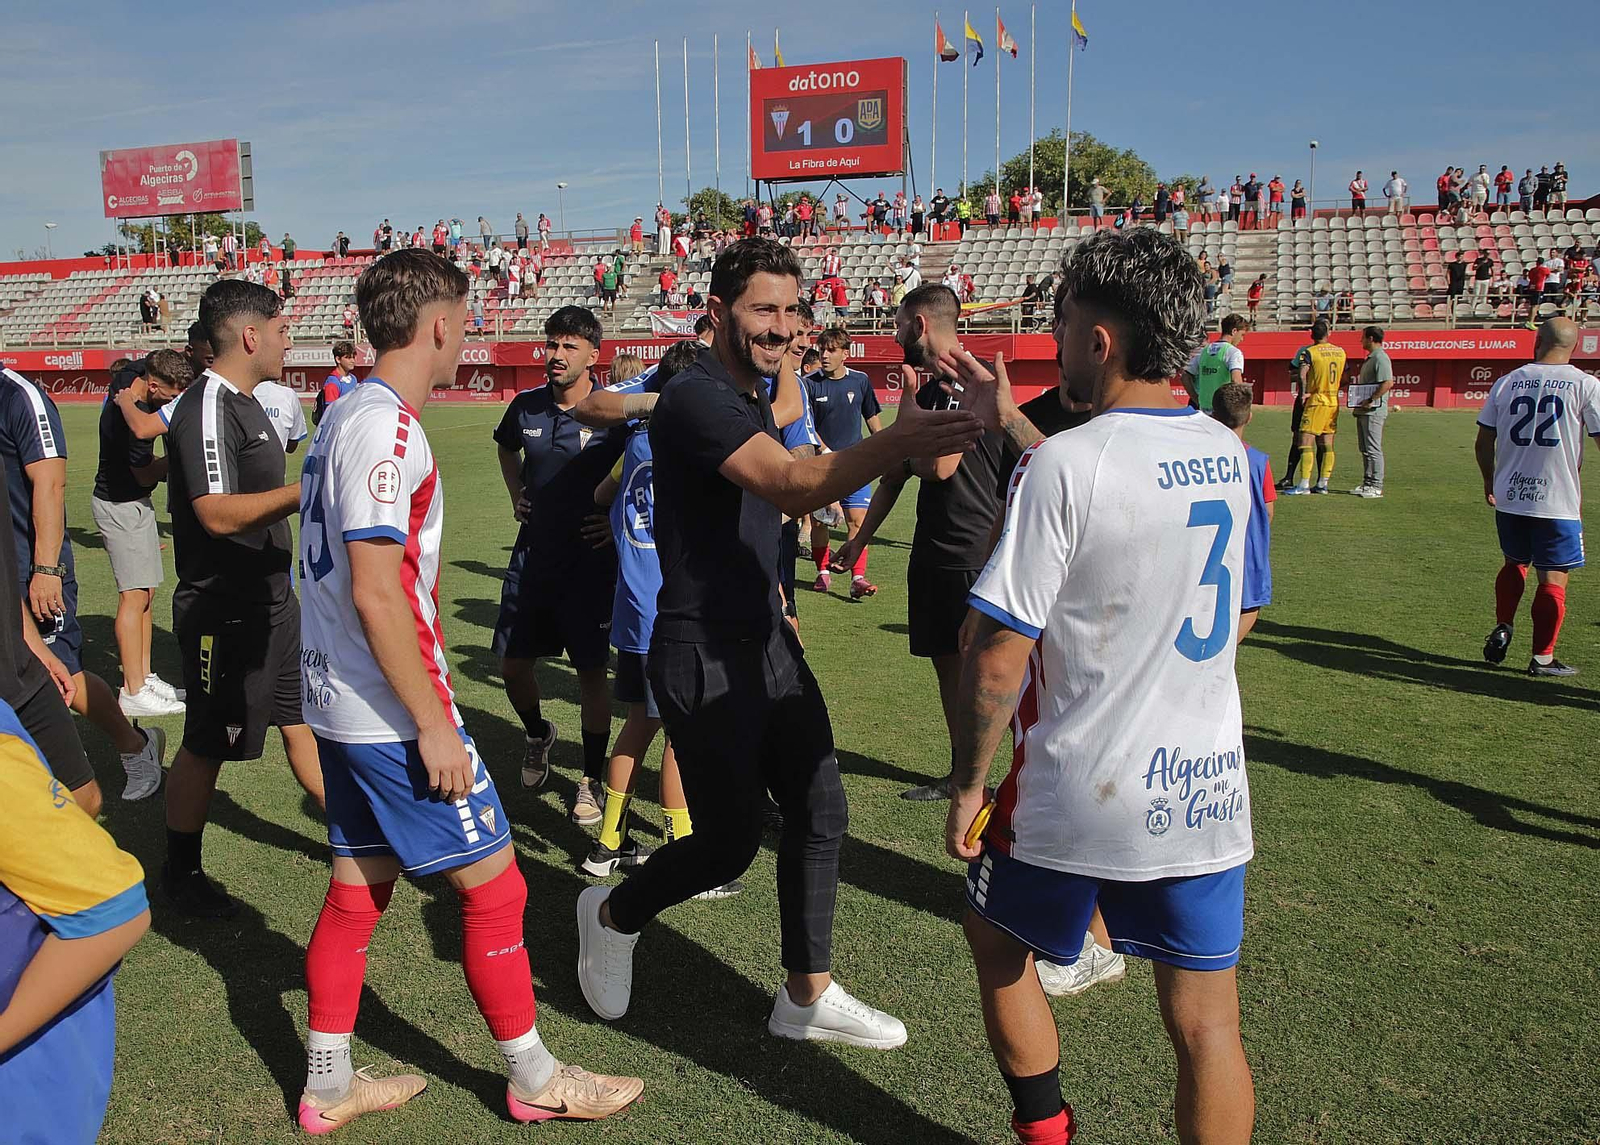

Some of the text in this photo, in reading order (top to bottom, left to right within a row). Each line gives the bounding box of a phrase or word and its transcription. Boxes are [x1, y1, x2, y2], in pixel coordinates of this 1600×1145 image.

[789, 71, 860, 91] datono
[798, 118, 854, 145] 1 0
[149, 163, 183, 174] Puerto de
[790, 156, 860, 169] La Fibra de Aquí
[140, 173, 184, 187] Algeciras
[1382, 340, 1517, 350] DISTRIBUCIONES LUMAR
[44, 352, 83, 369] capelli
[460, 349, 489, 362] CCO
[1329, 361, 1337, 385] 6
[1511, 379, 1573, 391] PARIS ADOT
[1509, 394, 1564, 447] 22
[1157, 456, 1242, 490] JOSECA
[1174, 499, 1234, 663] 3
[1142, 746, 1241, 801] Algeciras
[1213, 779, 1230, 794] me
[1185, 788, 1243, 829] Gusta
